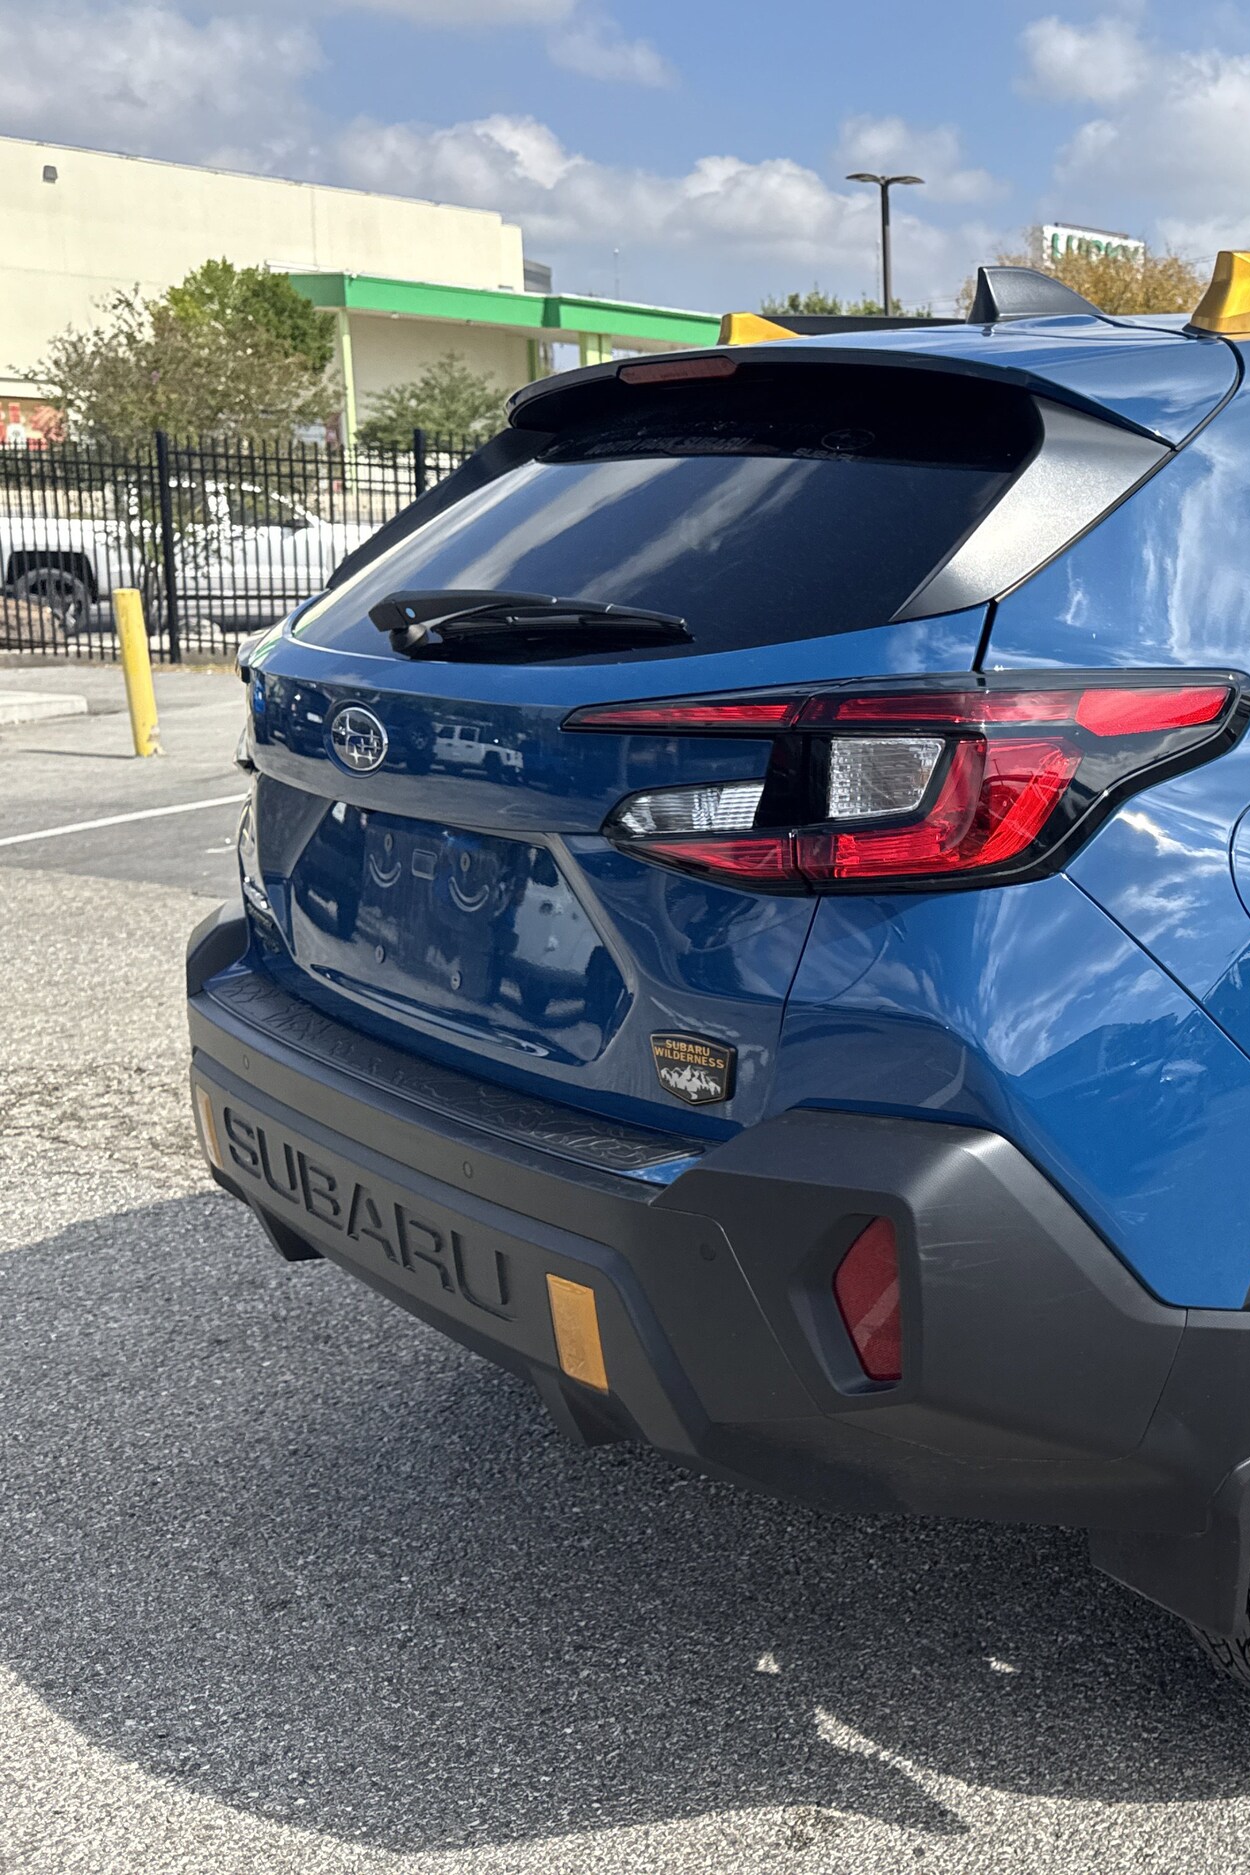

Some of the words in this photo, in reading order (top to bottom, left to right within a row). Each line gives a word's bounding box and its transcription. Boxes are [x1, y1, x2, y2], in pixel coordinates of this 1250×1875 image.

[655, 1047, 724, 1068] WILDERNESS
[666, 1040, 709, 1056] SUBARU
[223, 1107, 516, 1321] SUBARU
